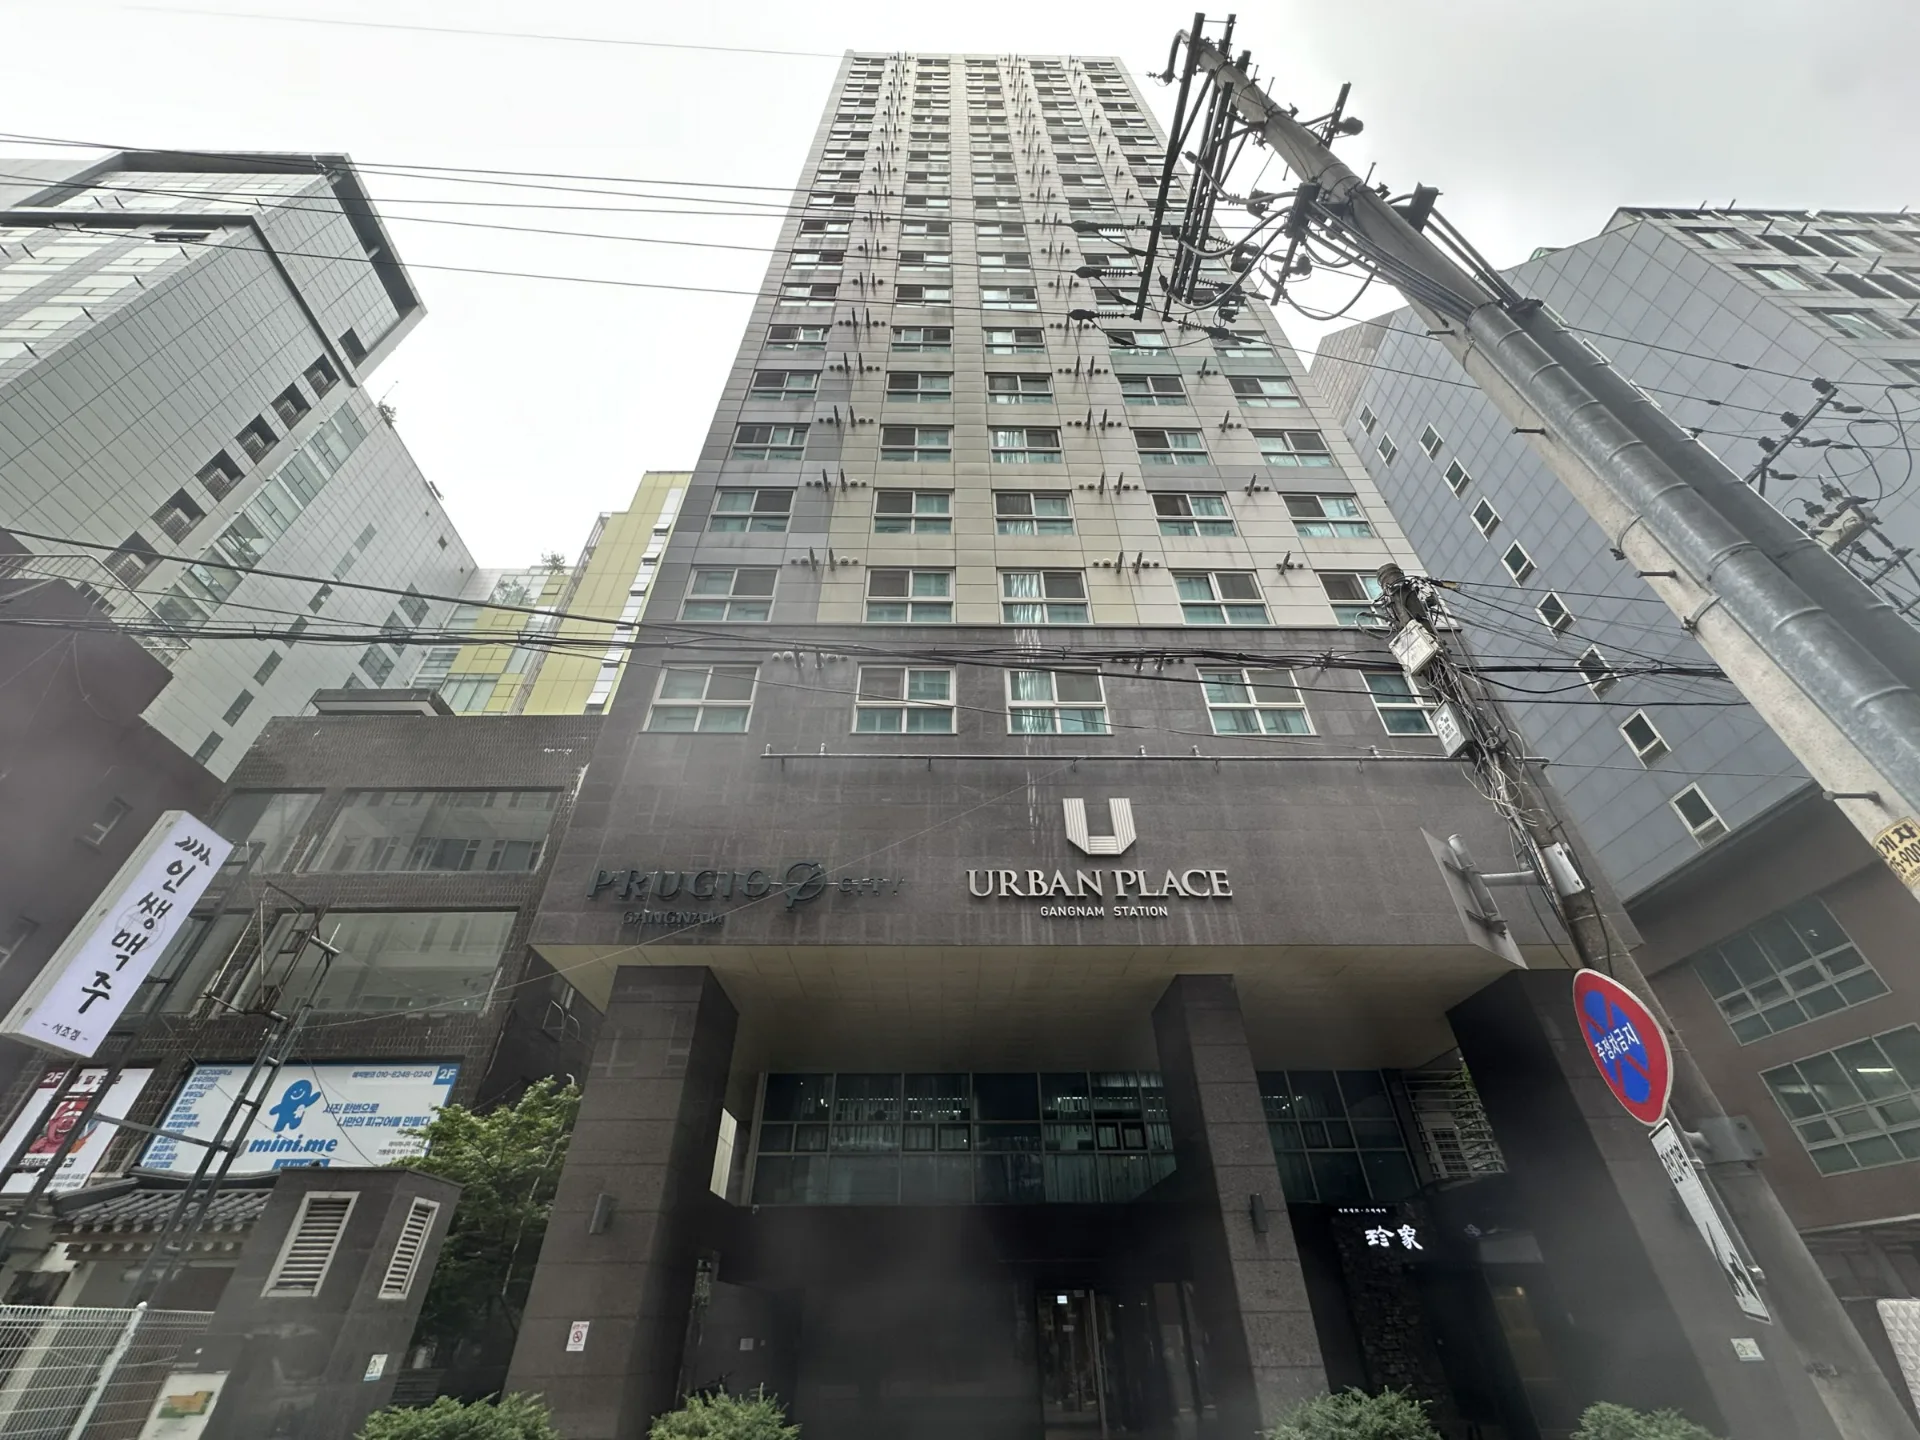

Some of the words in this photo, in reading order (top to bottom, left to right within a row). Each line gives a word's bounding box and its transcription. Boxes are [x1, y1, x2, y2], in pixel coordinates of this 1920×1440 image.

[586, 870, 772, 898] PRUGIO
[966, 869, 1103, 897] URBAN
[1111, 869, 1233, 897] PLACE
[1040, 906, 1105, 917] GANGNAM
[1113, 906, 1169, 917] STATION
[622, 910, 726, 926] GANGNAM
[1594, 1022, 1641, 1064] 주정차금지
[42, 1072, 65, 1084] 2F
[438, 1068, 457, 1080] 2F
[323, 1103, 342, 1114] 사진
[342, 1103, 380, 1114] 한번으로
[337, 1116, 366, 1127] 나만의
[365, 1116, 401, 1127] 피규어를
[402, 1116, 431, 1127] 만들다
